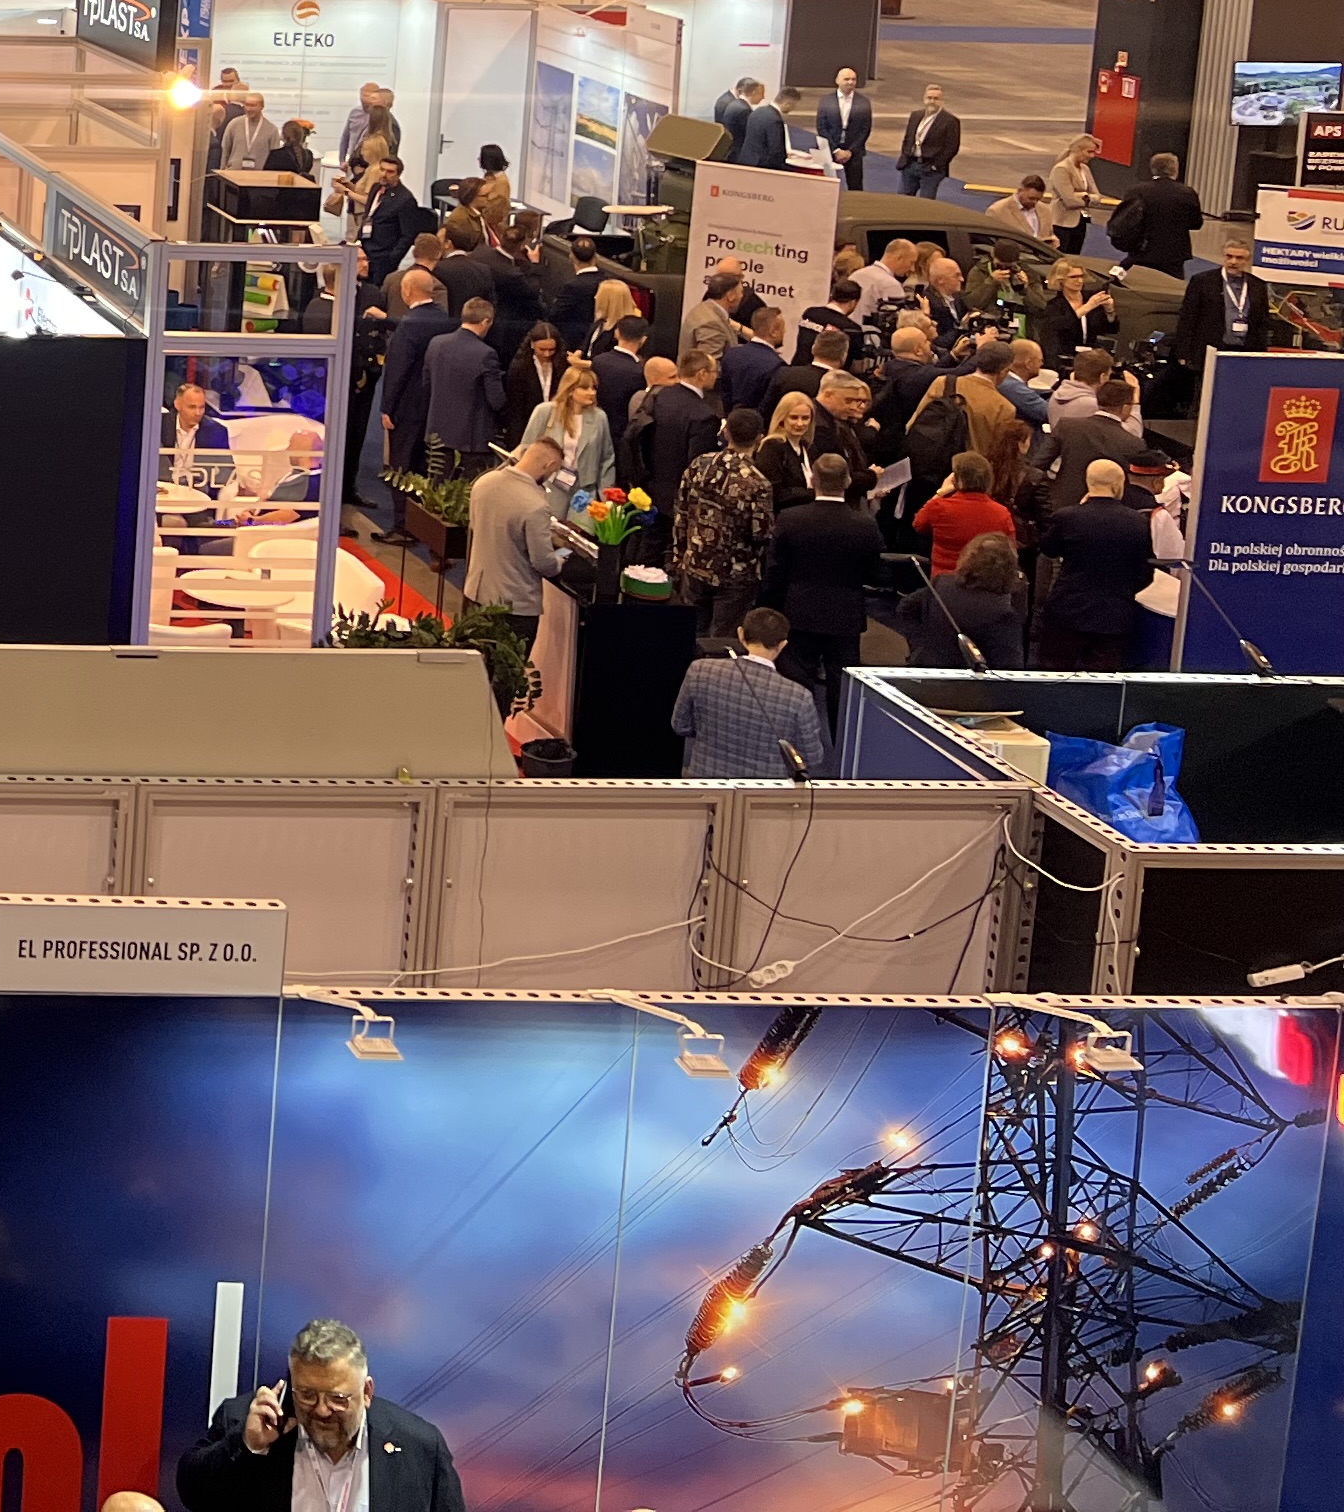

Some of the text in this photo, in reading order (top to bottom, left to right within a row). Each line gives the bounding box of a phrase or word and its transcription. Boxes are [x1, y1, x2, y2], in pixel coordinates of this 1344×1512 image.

[273, 32, 334, 47] ELFEKO
[1314, 125, 1342, 137] APS
[722, 189, 775, 203] KONGSBERG
[706, 233, 809, 264] Protechting
[1221, 495, 1344, 515] KONGSBER
[1210, 542, 1231, 554] Dla
[1234, 543, 1282, 557] polskiej
[1209, 559, 1229, 571] Dla
[1231, 560, 1280, 574] polskiej
[18, 939, 37, 959] EL
[43, 940, 172, 961] PROFESSIONAL
[177, 942, 203, 962] SP.
[209, 943, 217, 962] Z
[223, 943, 257, 963] O.O.
